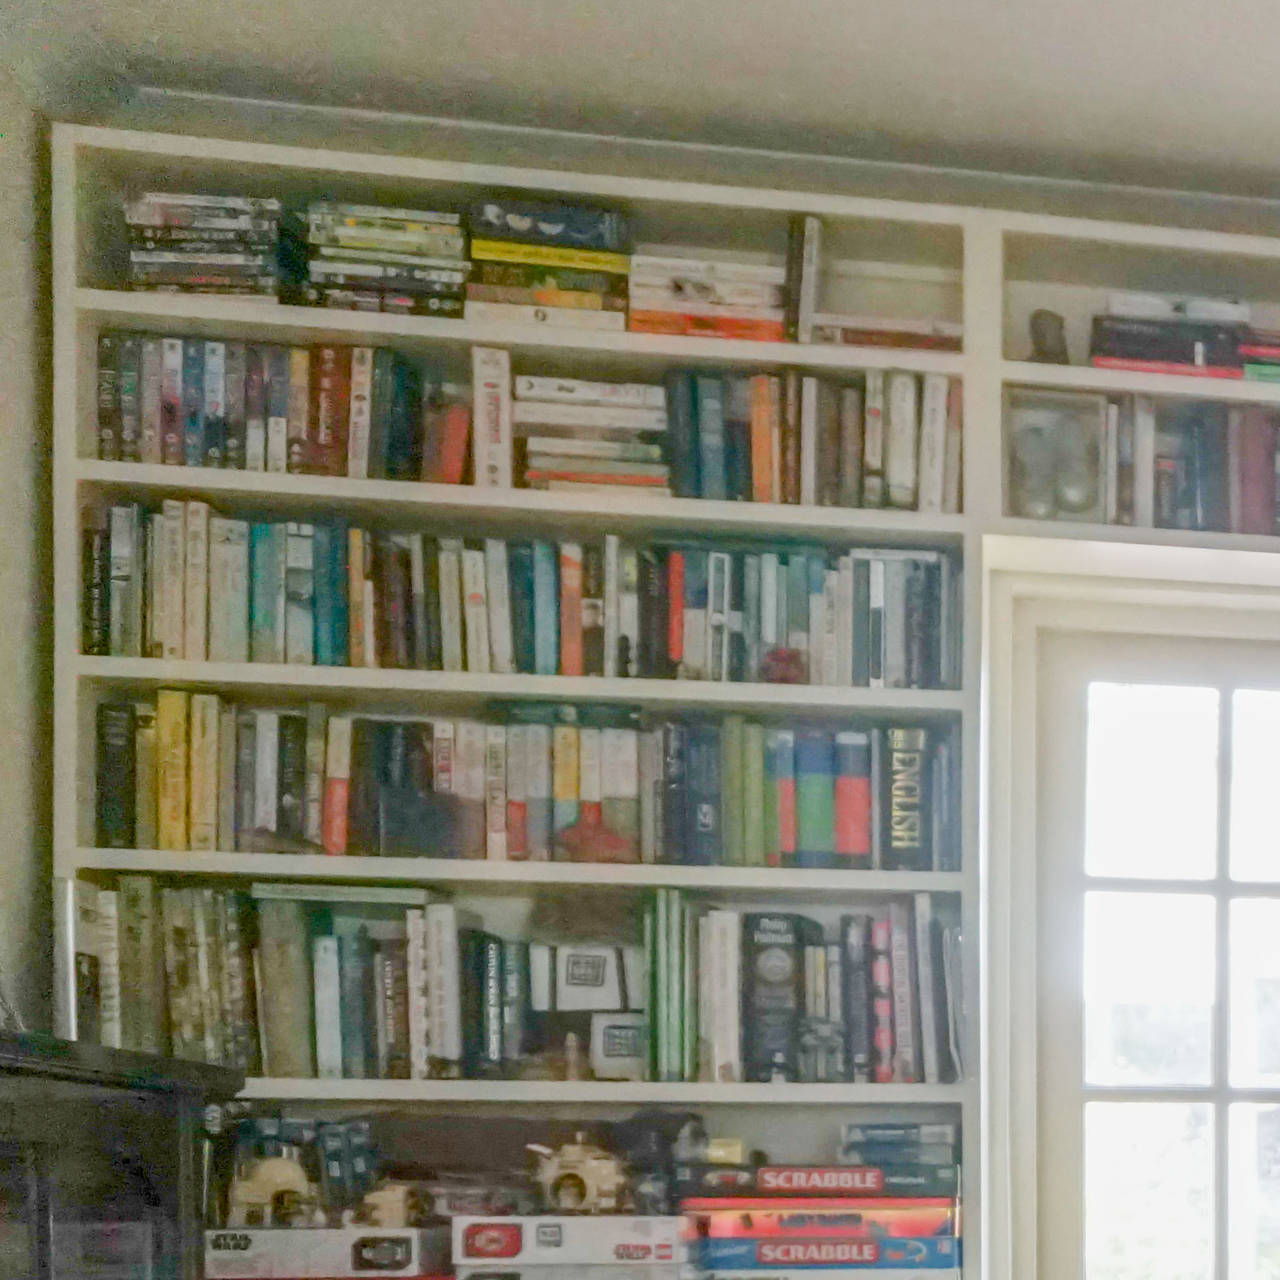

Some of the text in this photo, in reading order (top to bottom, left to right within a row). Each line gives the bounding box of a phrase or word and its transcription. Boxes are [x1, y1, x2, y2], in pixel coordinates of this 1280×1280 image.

[891, 751, 920, 848] ENGLISH
[763, 1169, 879, 1189] SCRABBLE
[760, 1242, 877, 1262] SCRABBLE
